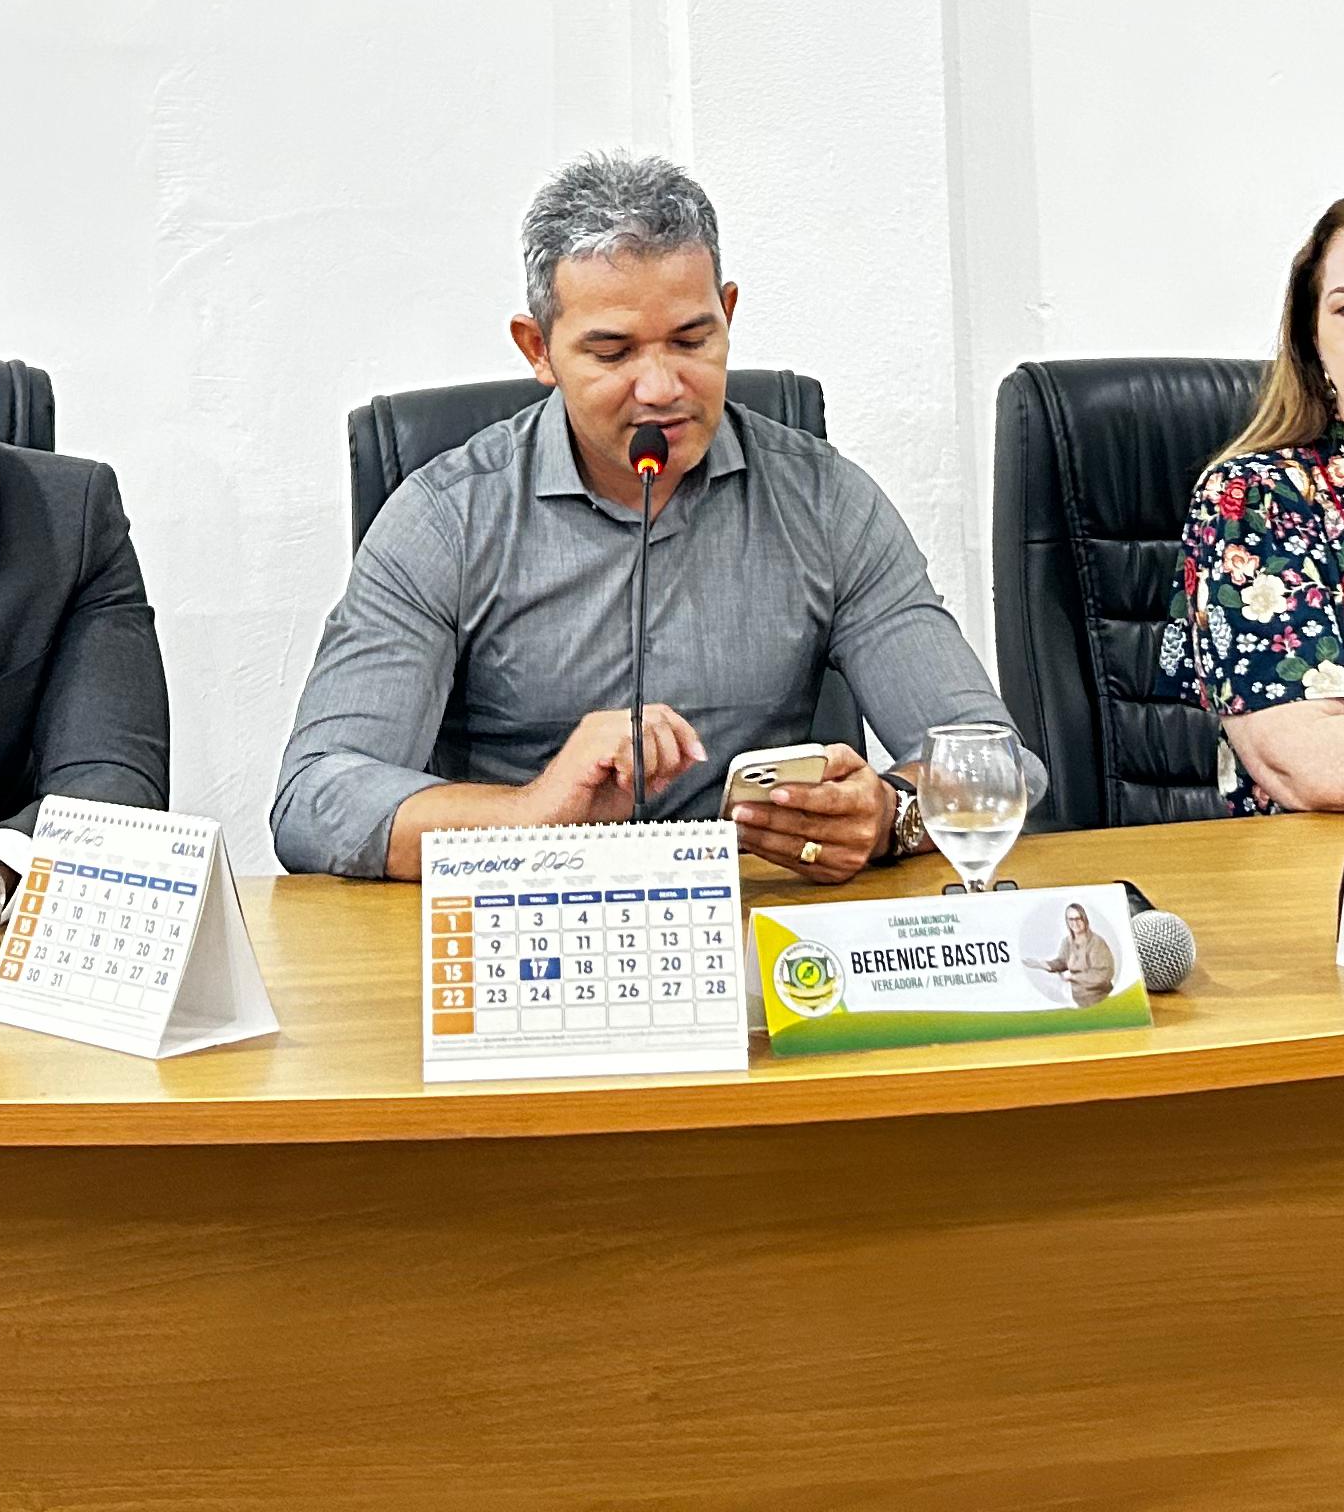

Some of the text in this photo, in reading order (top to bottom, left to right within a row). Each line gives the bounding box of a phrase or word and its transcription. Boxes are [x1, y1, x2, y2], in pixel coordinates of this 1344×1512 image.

[170, 841, 206, 859] CAIXA
[672, 846, 730, 861] CAIXA
[57, 879, 64, 892] 2
[79, 884, 87, 897] 3
[104, 888, 112, 900] 4
[127, 892, 135, 905] 5
[151, 896, 159, 910] 6
[177, 901, 184, 914] 7
[51, 902, 58, 914] 9
[72, 906, 83, 920] 10
[97, 911, 107, 924] 11
[120, 915, 131, 929] 12
[144, 919, 156, 934] 13
[169, 924, 181, 938] 14
[447, 905, 717, 931] 1 2 3 4 5 6 7
[42, 923, 53, 937] 16
[66, 929, 77, 942] 17
[89, 933, 101, 947] 18
[113, 938, 125, 952] 19
[136, 942, 151, 957] 20
[162, 947, 175, 961] 21
[447, 930, 722, 957] 8 9 10 11 12 13 14
[897, 927, 908, 939] DE
[33, 945, 48, 960] 23
[57, 950, 71, 964] 24
[81, 956, 95, 970] 25
[105, 960, 118, 974] 26
[129, 965, 144, 980] 27
[154, 970, 169, 985] 28
[443, 955, 724, 981] 15 16 17 18 19 20 21
[850, 945, 939, 975] BERENICE
[941, 940, 1011, 968] BASTOS
[26, 968, 40, 982] 30
[50, 973, 63, 987] 31
[871, 976, 924, 992] VEREADORA
[932, 971, 998, 988] REPUBLICANOS
[442, 980, 726, 1007] 22 23 24 25 26 27 28
